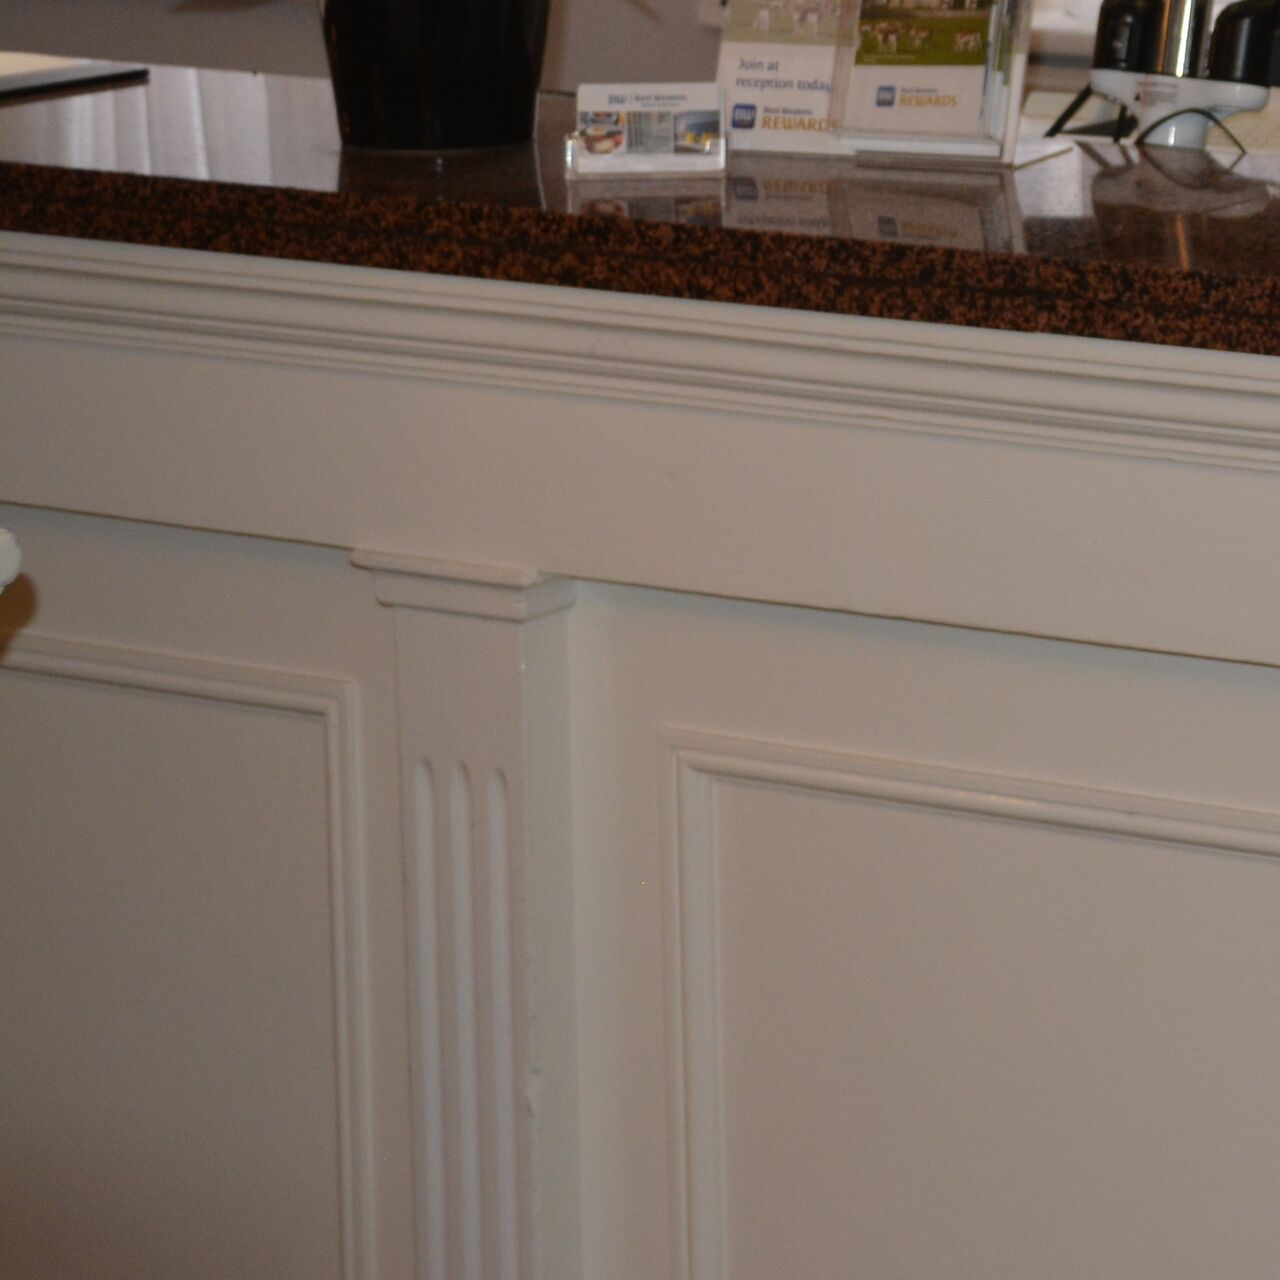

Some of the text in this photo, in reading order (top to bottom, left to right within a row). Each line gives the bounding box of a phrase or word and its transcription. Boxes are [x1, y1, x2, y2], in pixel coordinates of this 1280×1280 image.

[738, 58, 779, 72] Join at
[735, 77, 832, 93] reception today
[900, 94, 958, 107] REWARDS
